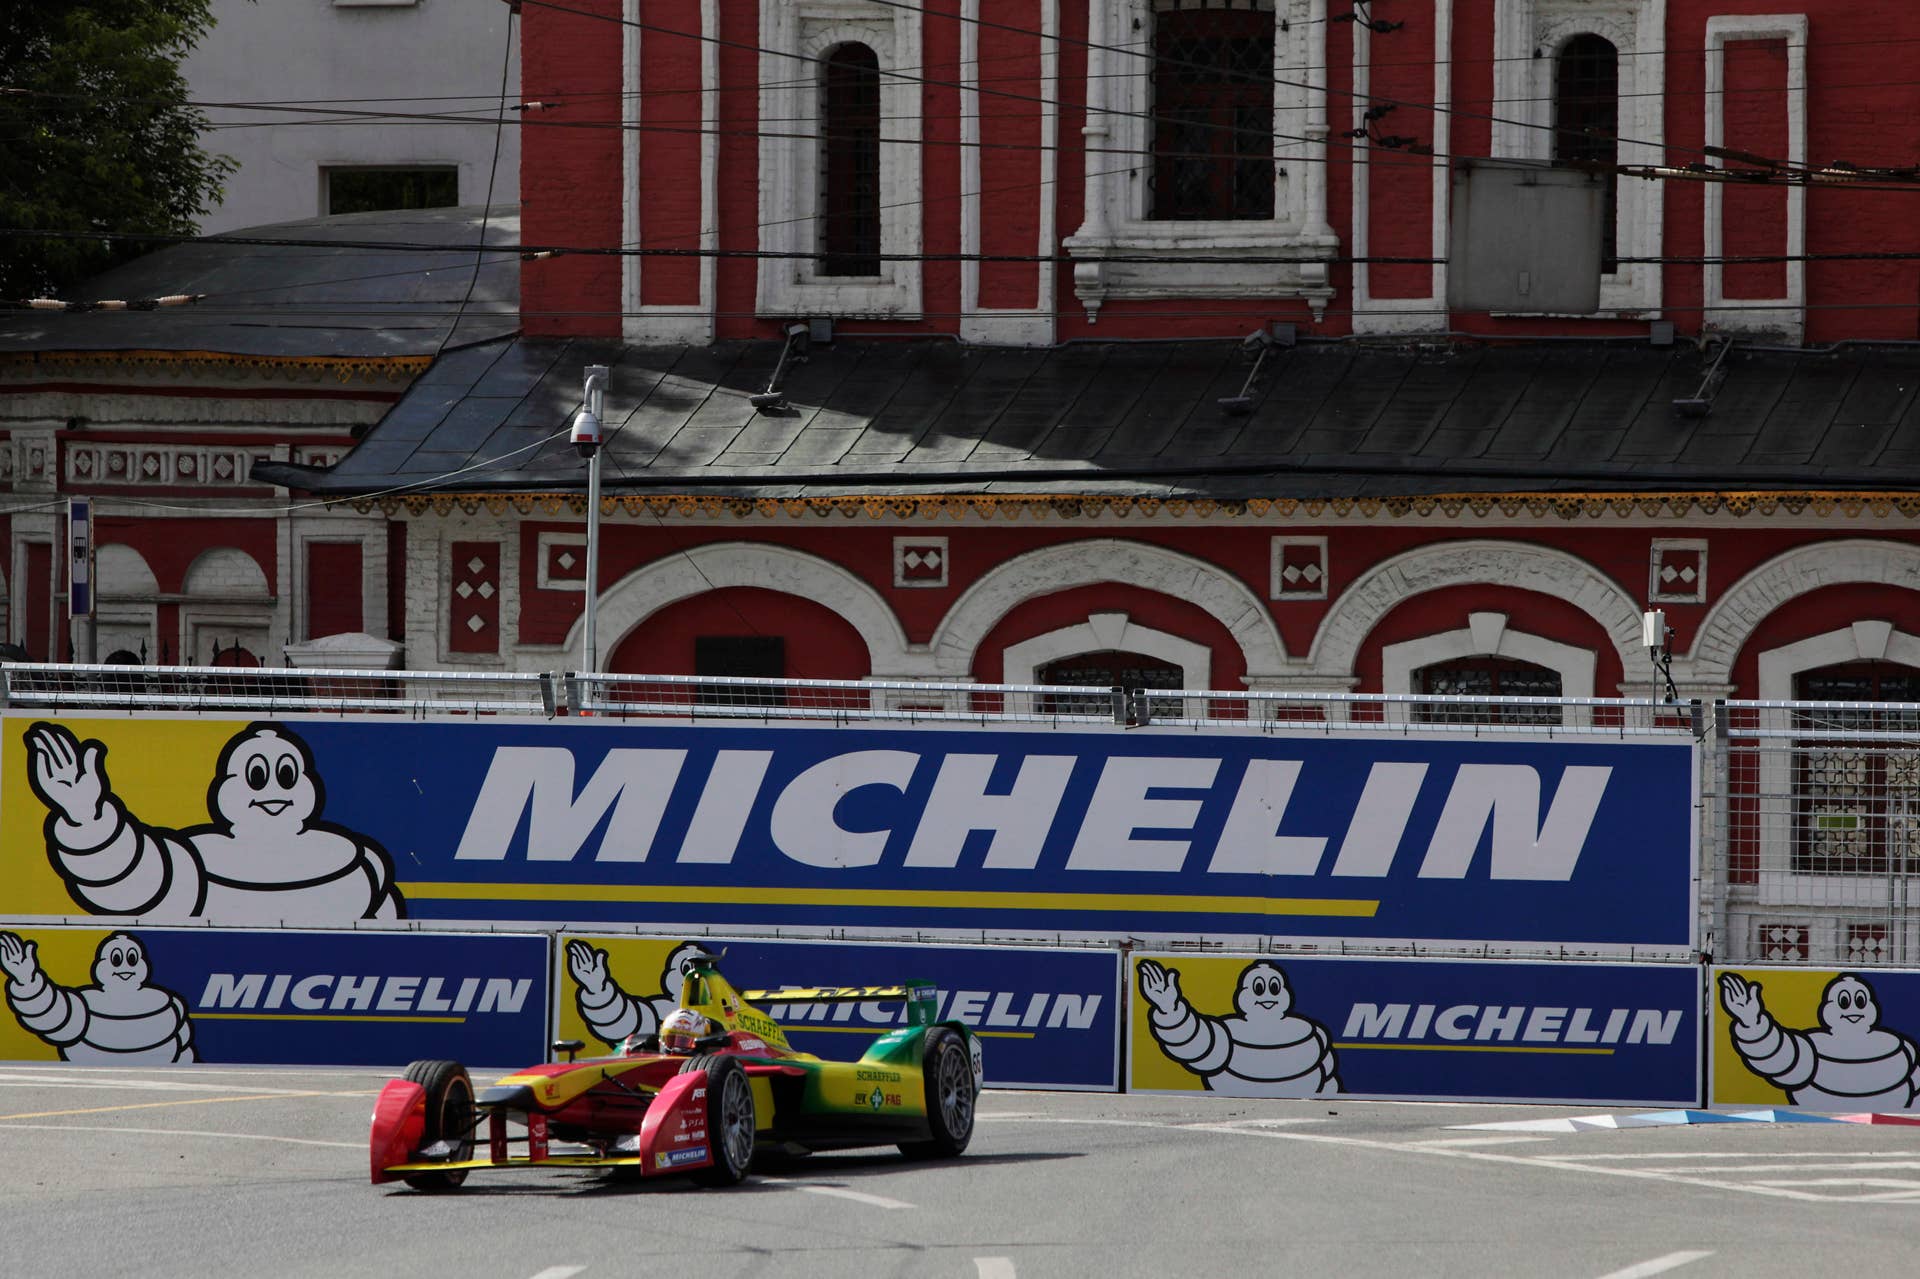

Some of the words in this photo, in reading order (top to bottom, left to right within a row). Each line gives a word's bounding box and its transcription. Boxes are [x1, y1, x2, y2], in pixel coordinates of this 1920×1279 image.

[455, 746, 1612, 881] MICHELIN
[199, 973, 532, 1012] MICHELIN
[1342, 1003, 1683, 1044] MICHELIN
[885, 1093, 902, 1105] FAG
[671, 1148, 707, 1161] MICHELIN
